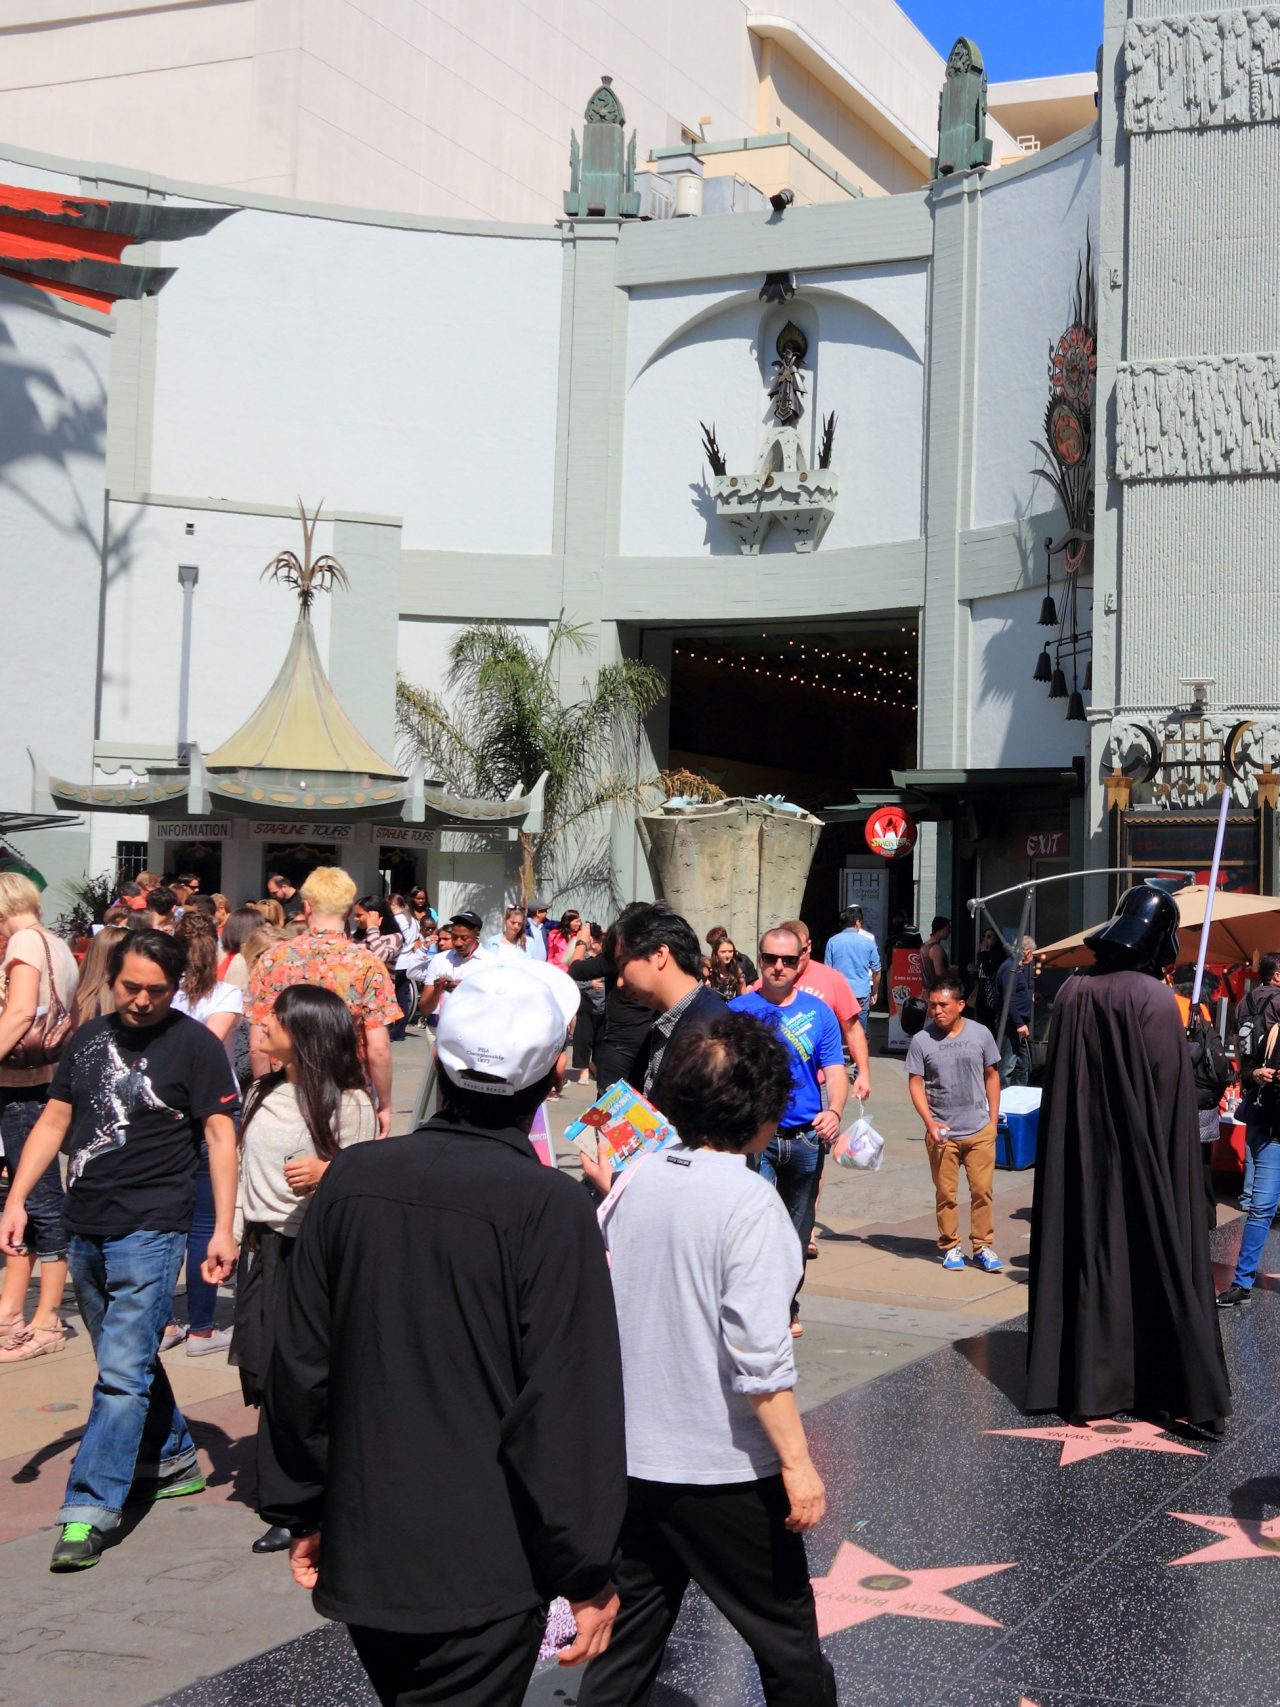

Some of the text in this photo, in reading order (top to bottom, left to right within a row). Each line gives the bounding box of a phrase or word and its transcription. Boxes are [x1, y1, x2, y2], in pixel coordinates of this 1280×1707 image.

[157, 823, 228, 838] INFORMATION
[253, 821, 351, 837] STARLINE TOURS
[375, 827, 434, 842] STARLINE TOURS
[1026, 832, 1063, 857] EXIT
[938, 1040, 970, 1051] DKNY
[486, 1086, 507, 1094] BEACH
[1046, 1431, 1157, 1448] HILARY SWANK
[899, 1602, 960, 1616] DREW
